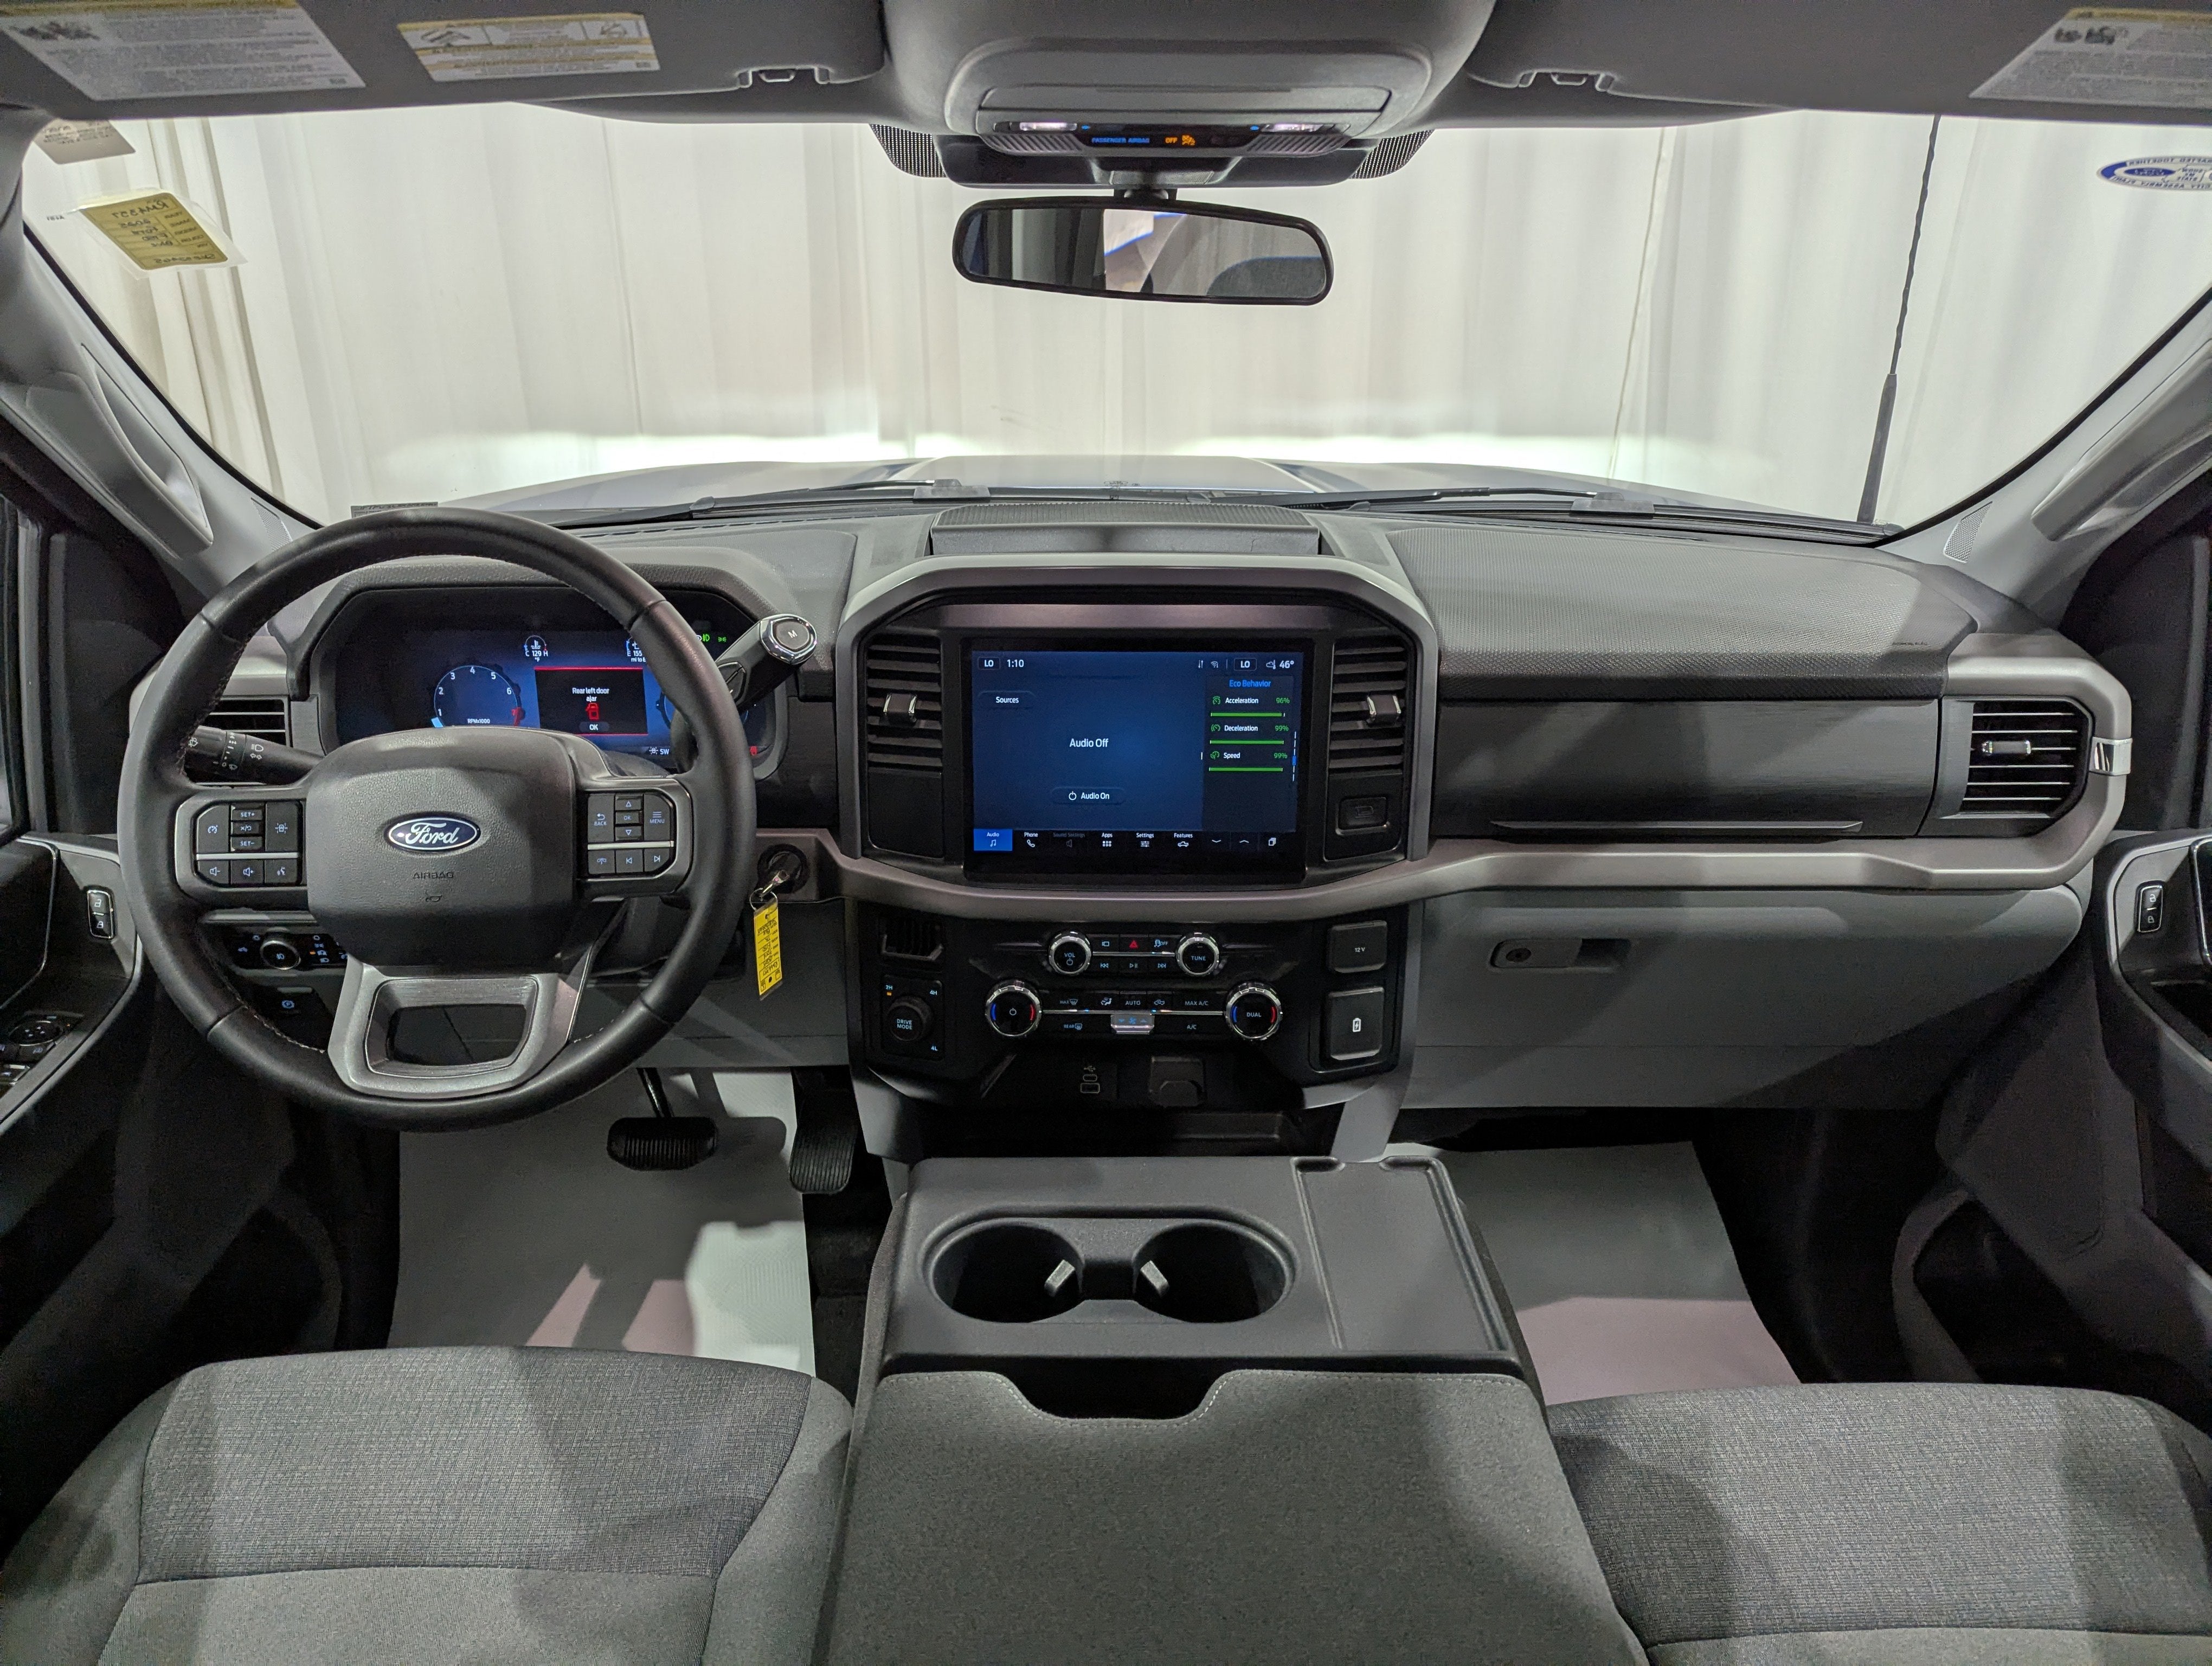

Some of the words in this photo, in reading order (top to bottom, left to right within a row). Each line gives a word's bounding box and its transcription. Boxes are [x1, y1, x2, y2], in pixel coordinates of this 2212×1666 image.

[788, 630, 798, 638] M
[1007, 659, 1024, 668] 1:10
[1279, 660, 1294, 669] 46°
[450, 672, 455, 680] 3
[438, 687, 443, 695] 2
[1069, 738, 1094, 747] Audio
[1095, 738, 1109, 747] Off
[406, 822, 460, 844] Ford
